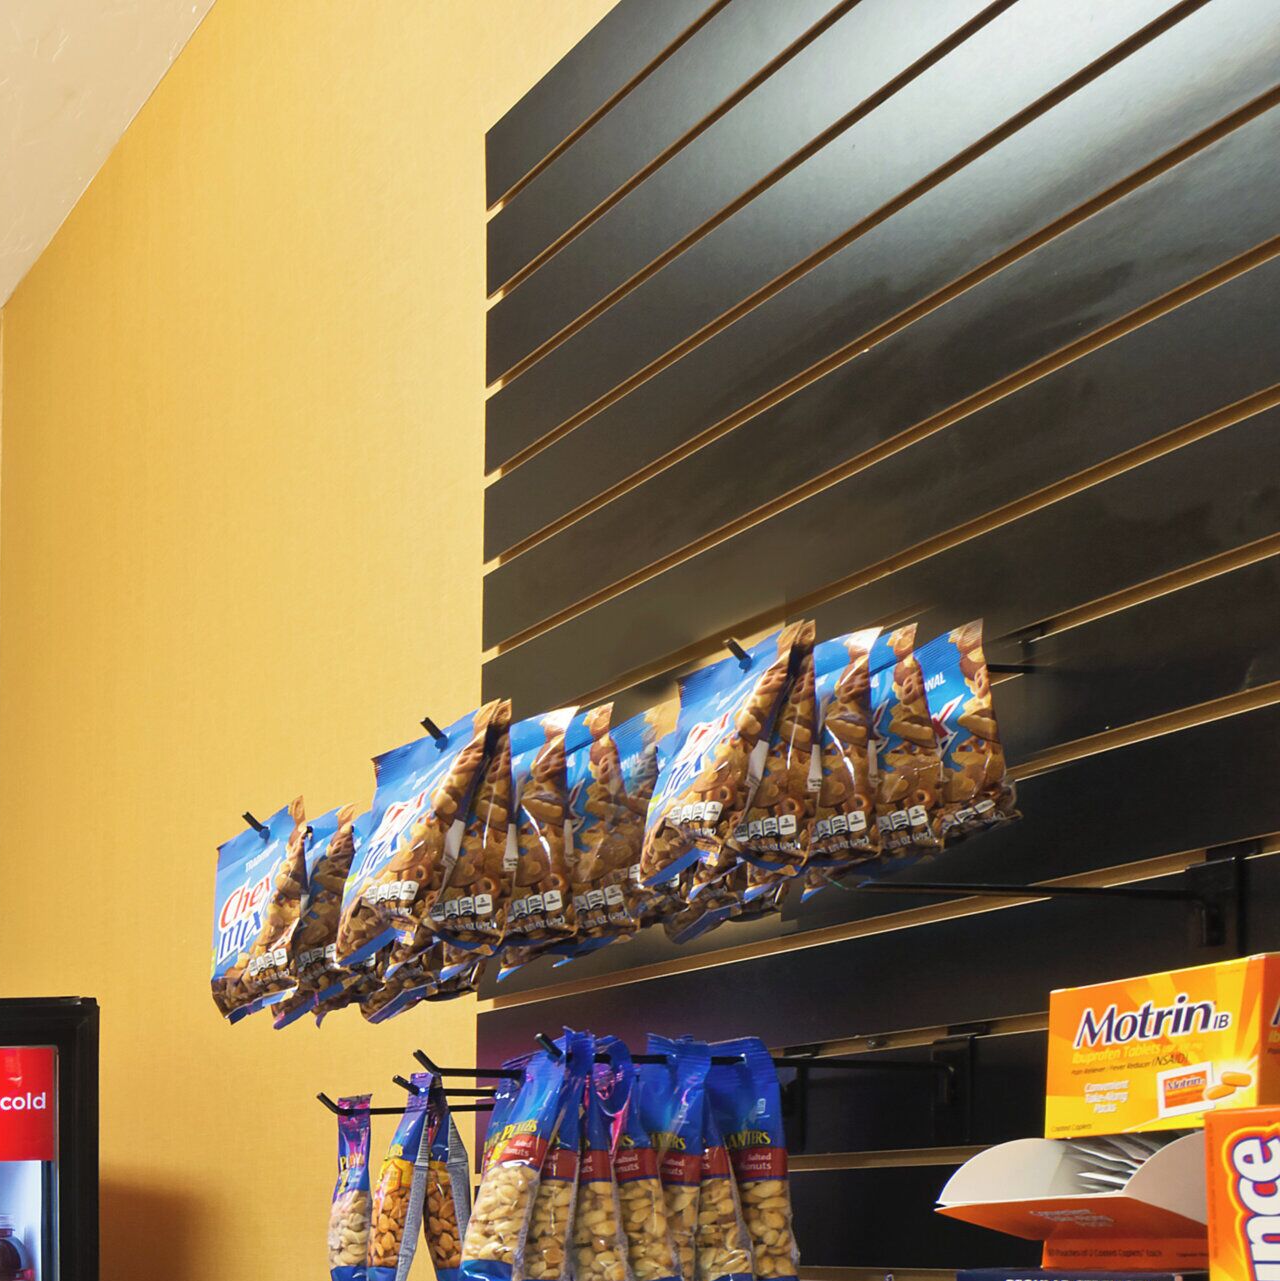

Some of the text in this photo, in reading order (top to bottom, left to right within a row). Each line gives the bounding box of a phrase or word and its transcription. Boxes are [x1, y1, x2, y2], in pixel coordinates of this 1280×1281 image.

[1073, 994, 1229, 1049] Motrin IB
[1123, 1043, 1161, 1059] Tablets
[0, 1092, 46, 1111] cold
